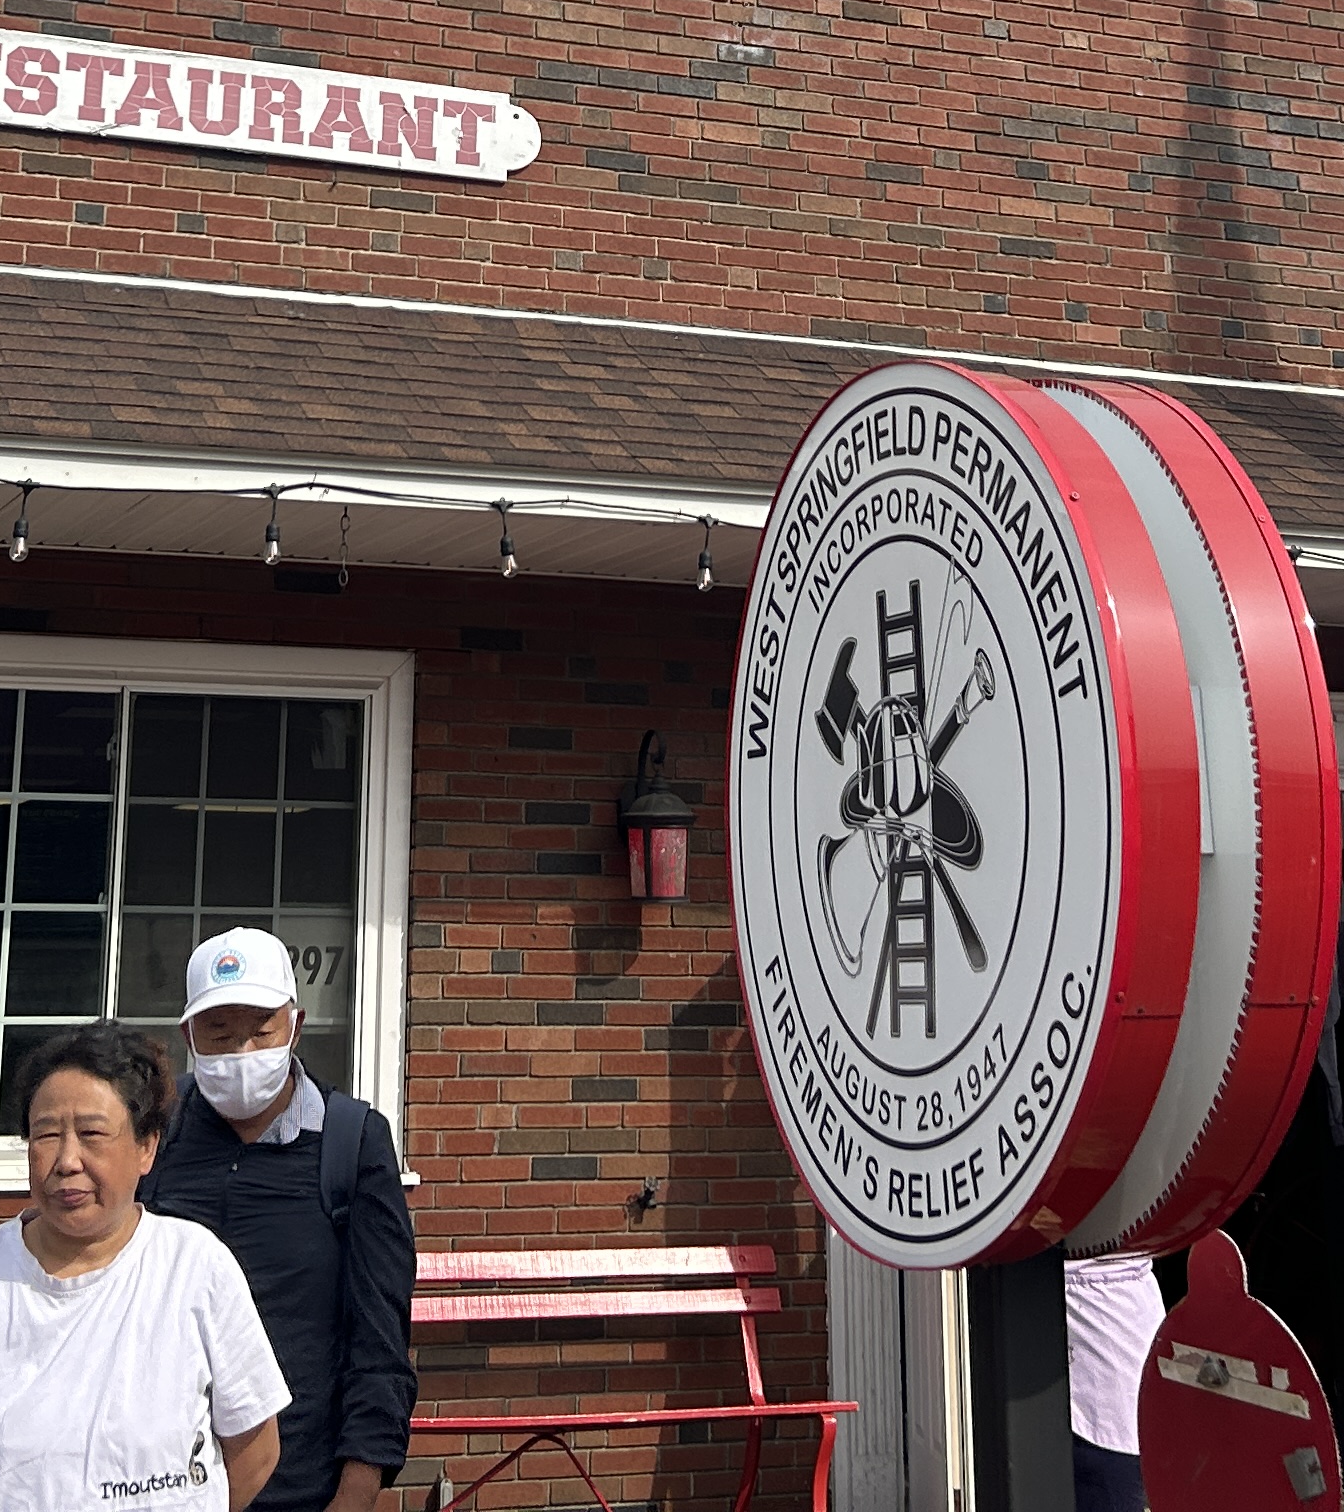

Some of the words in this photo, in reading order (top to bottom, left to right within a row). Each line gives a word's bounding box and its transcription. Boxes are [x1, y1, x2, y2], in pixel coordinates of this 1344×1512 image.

[747, 583, 787, 759] WEST
[777, 405, 926, 593] SPRINGFIELD
[932, 411, 1088, 700] PERMANENT
[807, 488, 984, 614] INCORPORATED
[764, 955, 880, 1201] FIREMEN'S
[887, 1148, 986, 1220] RELIEF
[997, 964, 1093, 1176] ASSOC.
[816, 1025, 908, 1132] AUGUST
[915, 1089, 955, 1133] 28,
[953, 1023, 1009, 1116] 1947
